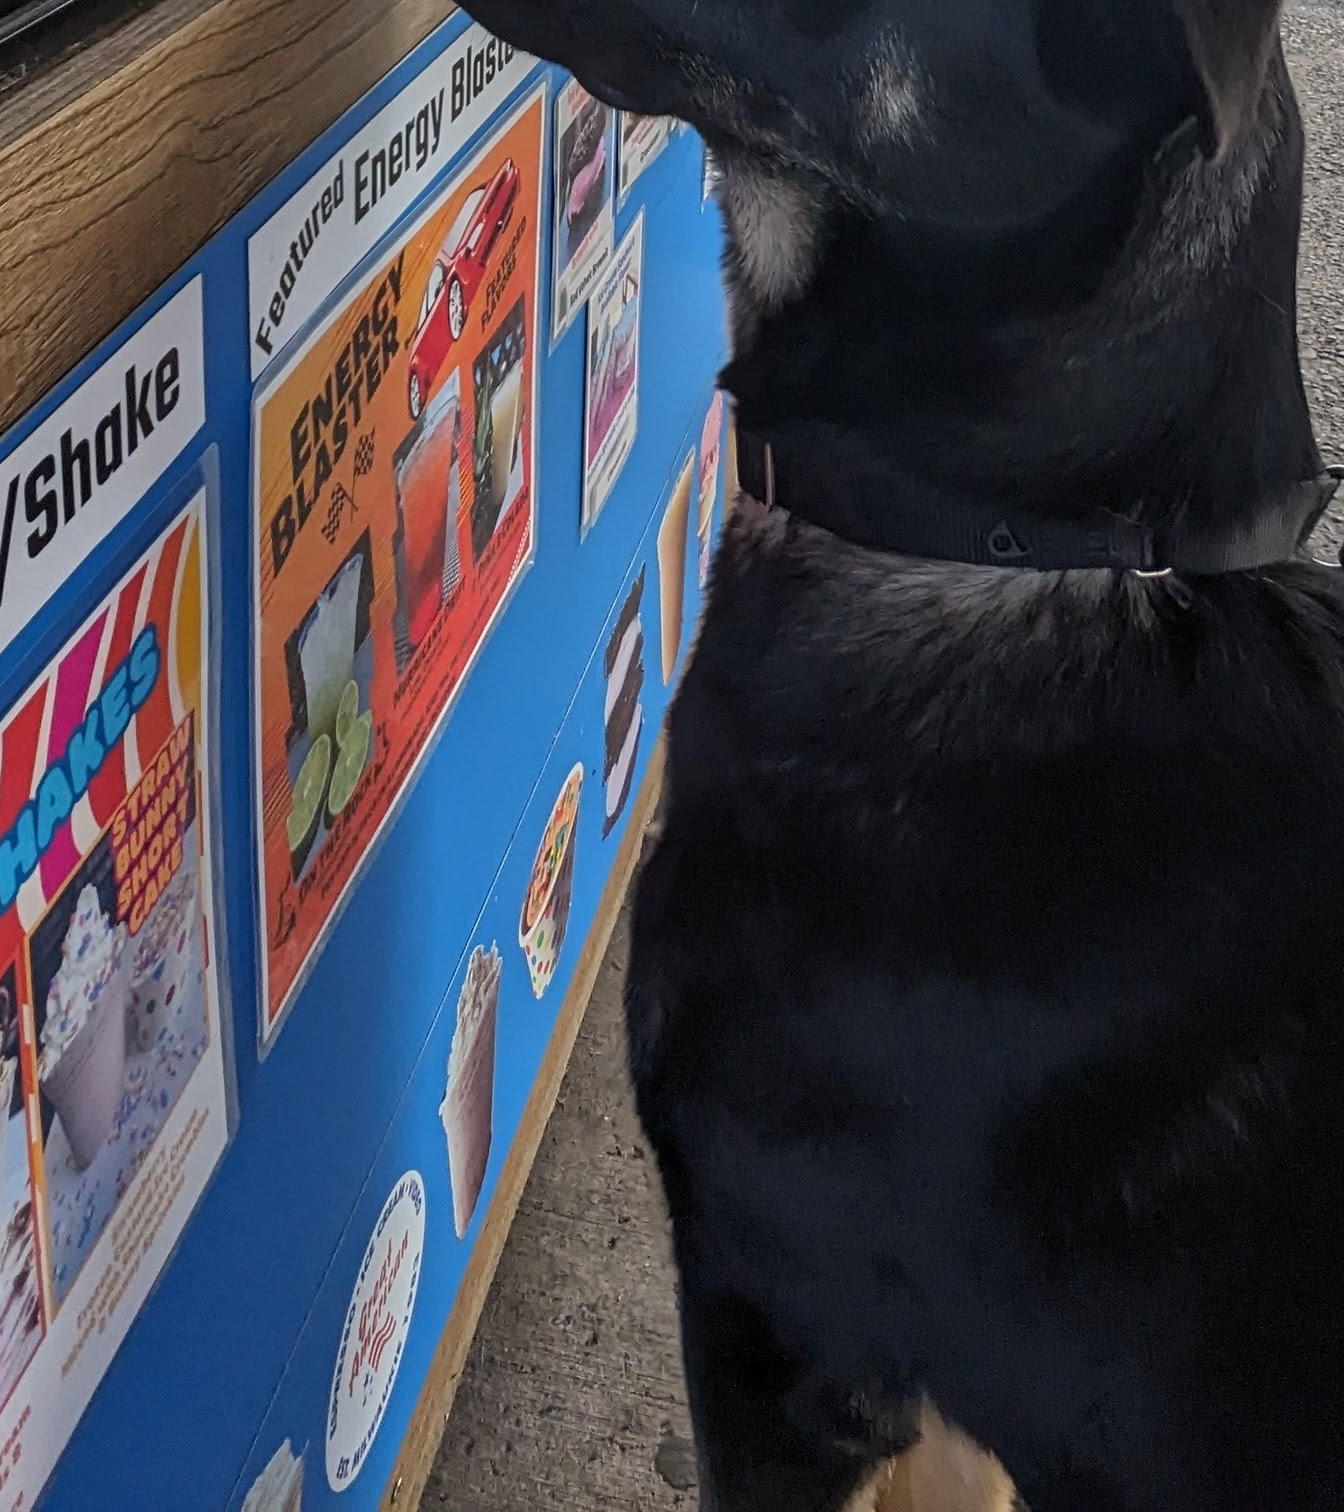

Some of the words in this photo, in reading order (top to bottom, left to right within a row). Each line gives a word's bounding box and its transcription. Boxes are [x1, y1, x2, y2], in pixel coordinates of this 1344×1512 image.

[254, 159, 345, 357] Featured
[354, 90, 447, 226] Energy
[449, 37, 514, 124] Blaste
[290, 254, 406, 478] ENERGY
[270, 324, 401, 578] BLASTER
[111, 714, 192, 848] STRAW
[115, 755, 189, 883] BUNNY
[116, 788, 189, 921] SHORT
[127, 838, 184, 938] CAKE
[349, 1228, 409, 1398] American
[359, 1238, 393, 1344] Great
